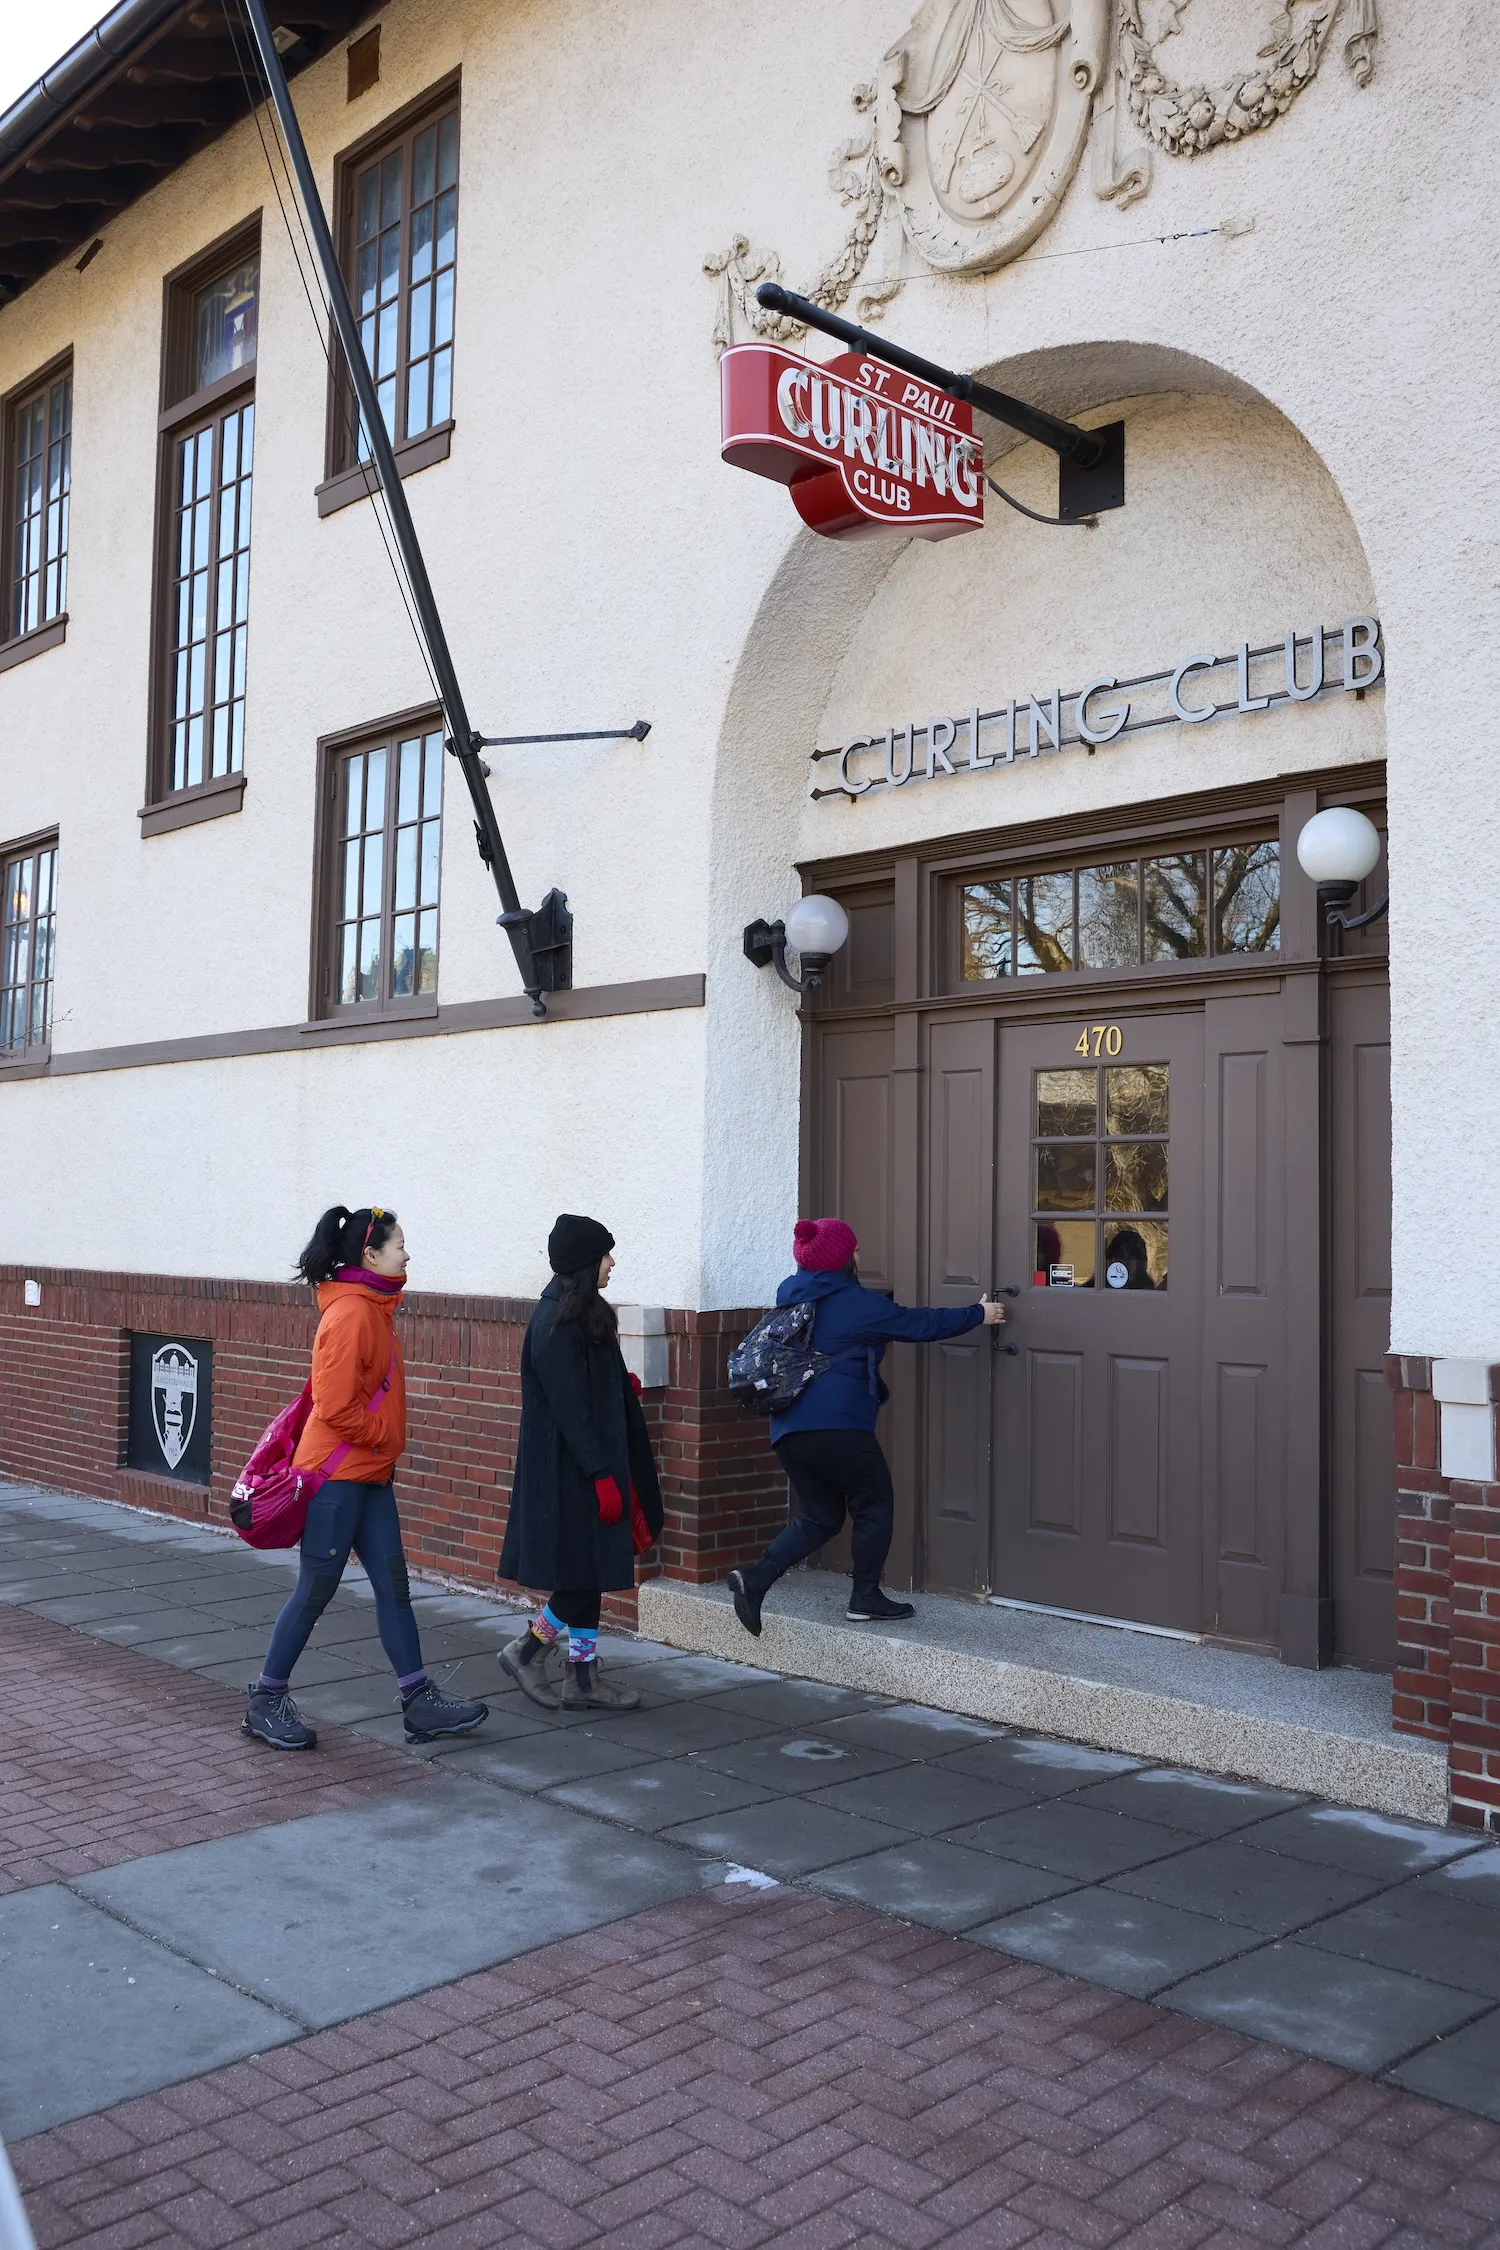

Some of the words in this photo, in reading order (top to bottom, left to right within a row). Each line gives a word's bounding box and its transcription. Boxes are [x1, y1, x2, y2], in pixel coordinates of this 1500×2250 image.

[855, 362, 891, 395] ST.
[901, 383, 956, 427] PAUL
[777, 367, 980, 508] CURLING
[853, 469, 911, 512] CLUB
[836, 676, 1131, 794] CURLING
[1168, 616, 1384, 724] CLUB
[1074, 1025, 1123, 1058] 470
